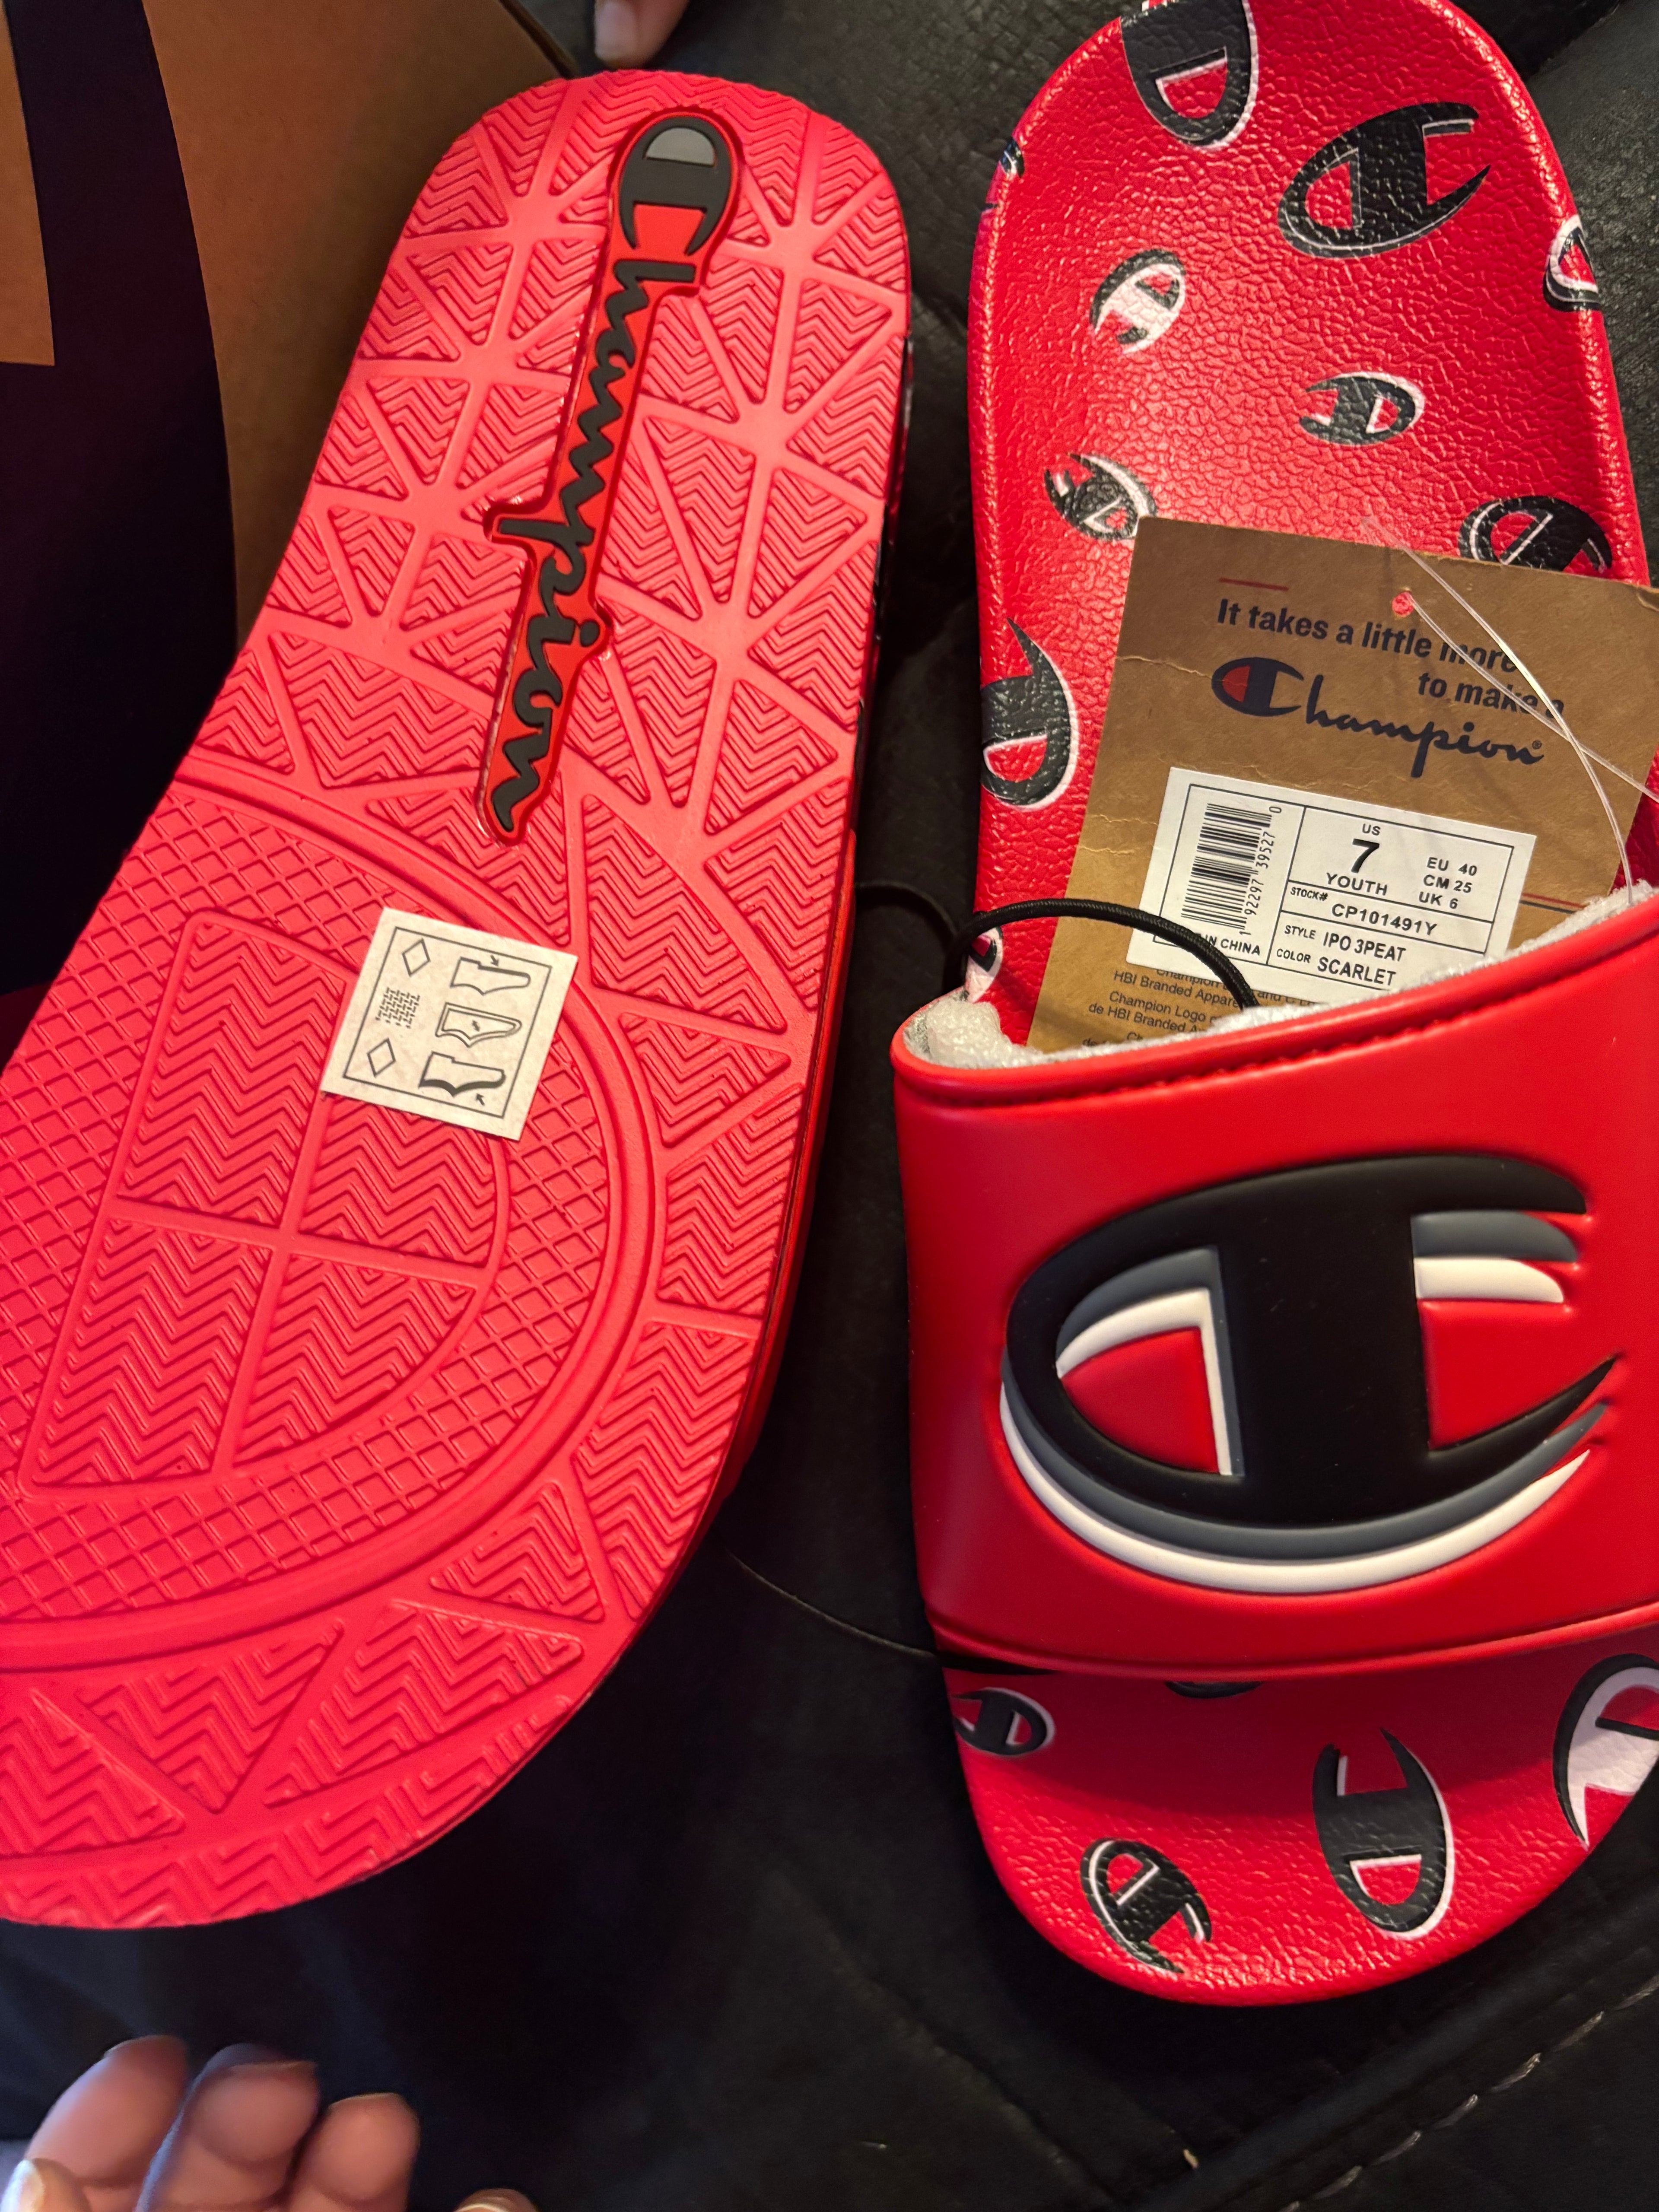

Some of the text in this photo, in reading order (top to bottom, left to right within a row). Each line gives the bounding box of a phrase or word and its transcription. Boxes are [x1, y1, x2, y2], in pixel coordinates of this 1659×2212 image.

[494, 116, 732, 832] Champion
[1217, 598, 1519, 673] It takes a little more
[1417, 672, 1564, 718] to make a
[1362, 823, 1381, 836] US
[1351, 838, 1380, 874] 7
[1427, 857, 1478, 876] EU 40
[1244, 879, 1264, 915] 92297
[1255, 831, 1275, 869] 39527
[1326, 872, 1388, 896] YOUTH
[1423, 874, 1472, 893] CM 25
[1290, 887, 1328, 901] STOCK#
[1419, 891, 1459, 909] UK 6
[1331, 903, 1437, 936] CP101491Y
[1220, 938, 1260, 956] CHINA
[1284, 925, 1406, 962] STYLE IPO 3PEAT
[1276, 948, 1396, 986] COLOR SCARLET
[1113, 970, 1137, 985] HBI
[1140, 976, 1193, 998] Branded
[1088, 1003, 1104, 1014] de
[1107, 1006, 1131, 1021] HBI
[1133, 1011, 1186, 1033] Branded
[1109, 991, 1206, 1023] Champion Logo
